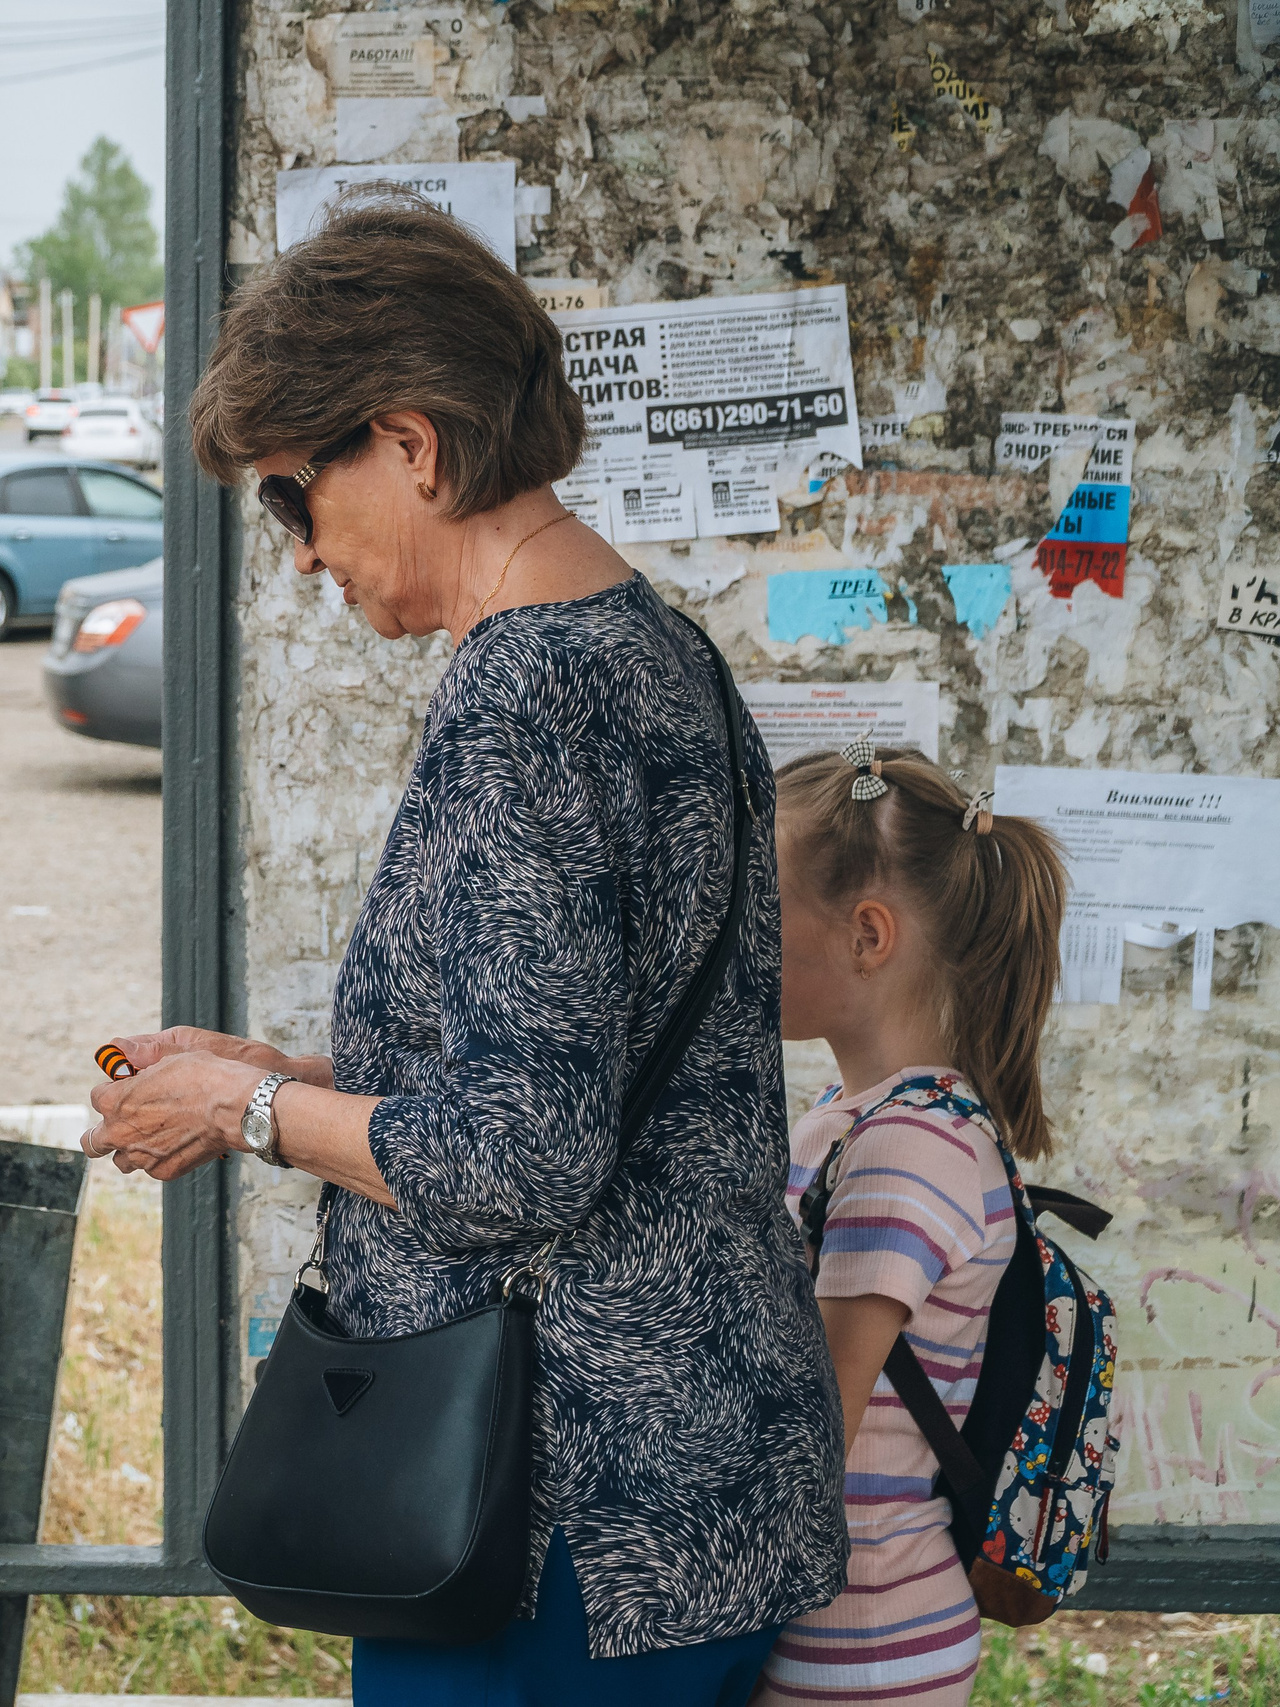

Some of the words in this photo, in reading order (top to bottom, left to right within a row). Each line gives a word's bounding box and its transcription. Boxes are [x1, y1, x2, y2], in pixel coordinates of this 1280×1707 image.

[350, 49, 415, 62] РАБОТА!!!
[565, 326, 646, 353] СТРАЯ
[568, 354, 639, 382] ДАЧА
[579, 379, 663, 407] ДИТОВ
[587, 411, 615, 424] СКИЙ
[649, 392, 845, 438] 8(861)290-71-60
[1106, 789, 1194, 809] Внимание
[1198, 793, 1223, 810] !!!
